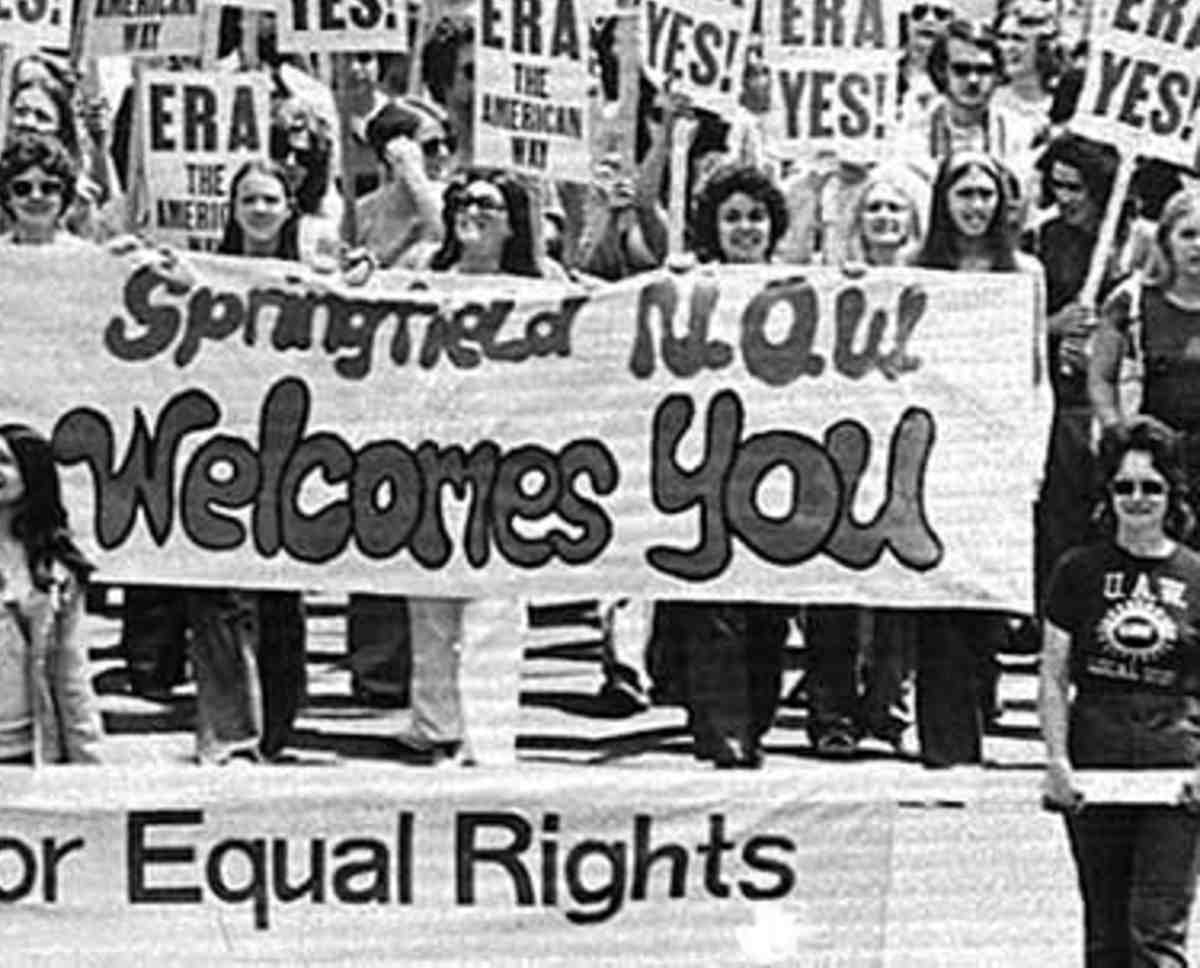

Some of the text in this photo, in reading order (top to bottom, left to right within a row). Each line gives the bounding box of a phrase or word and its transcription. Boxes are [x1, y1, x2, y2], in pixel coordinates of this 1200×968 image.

[513, 61, 551, 99] THE
[777, 69, 887, 140] YES!
[149, 82, 262, 153] ERA
[482, 93, 584, 140] AMERICAN
[184, 162, 226, 197] THE
[104, 264, 591, 380] Springfield
[52, 375, 619, 570] Welcomes
[127, 809, 413, 931] Equal
[456, 810, 800, 925] Rights
